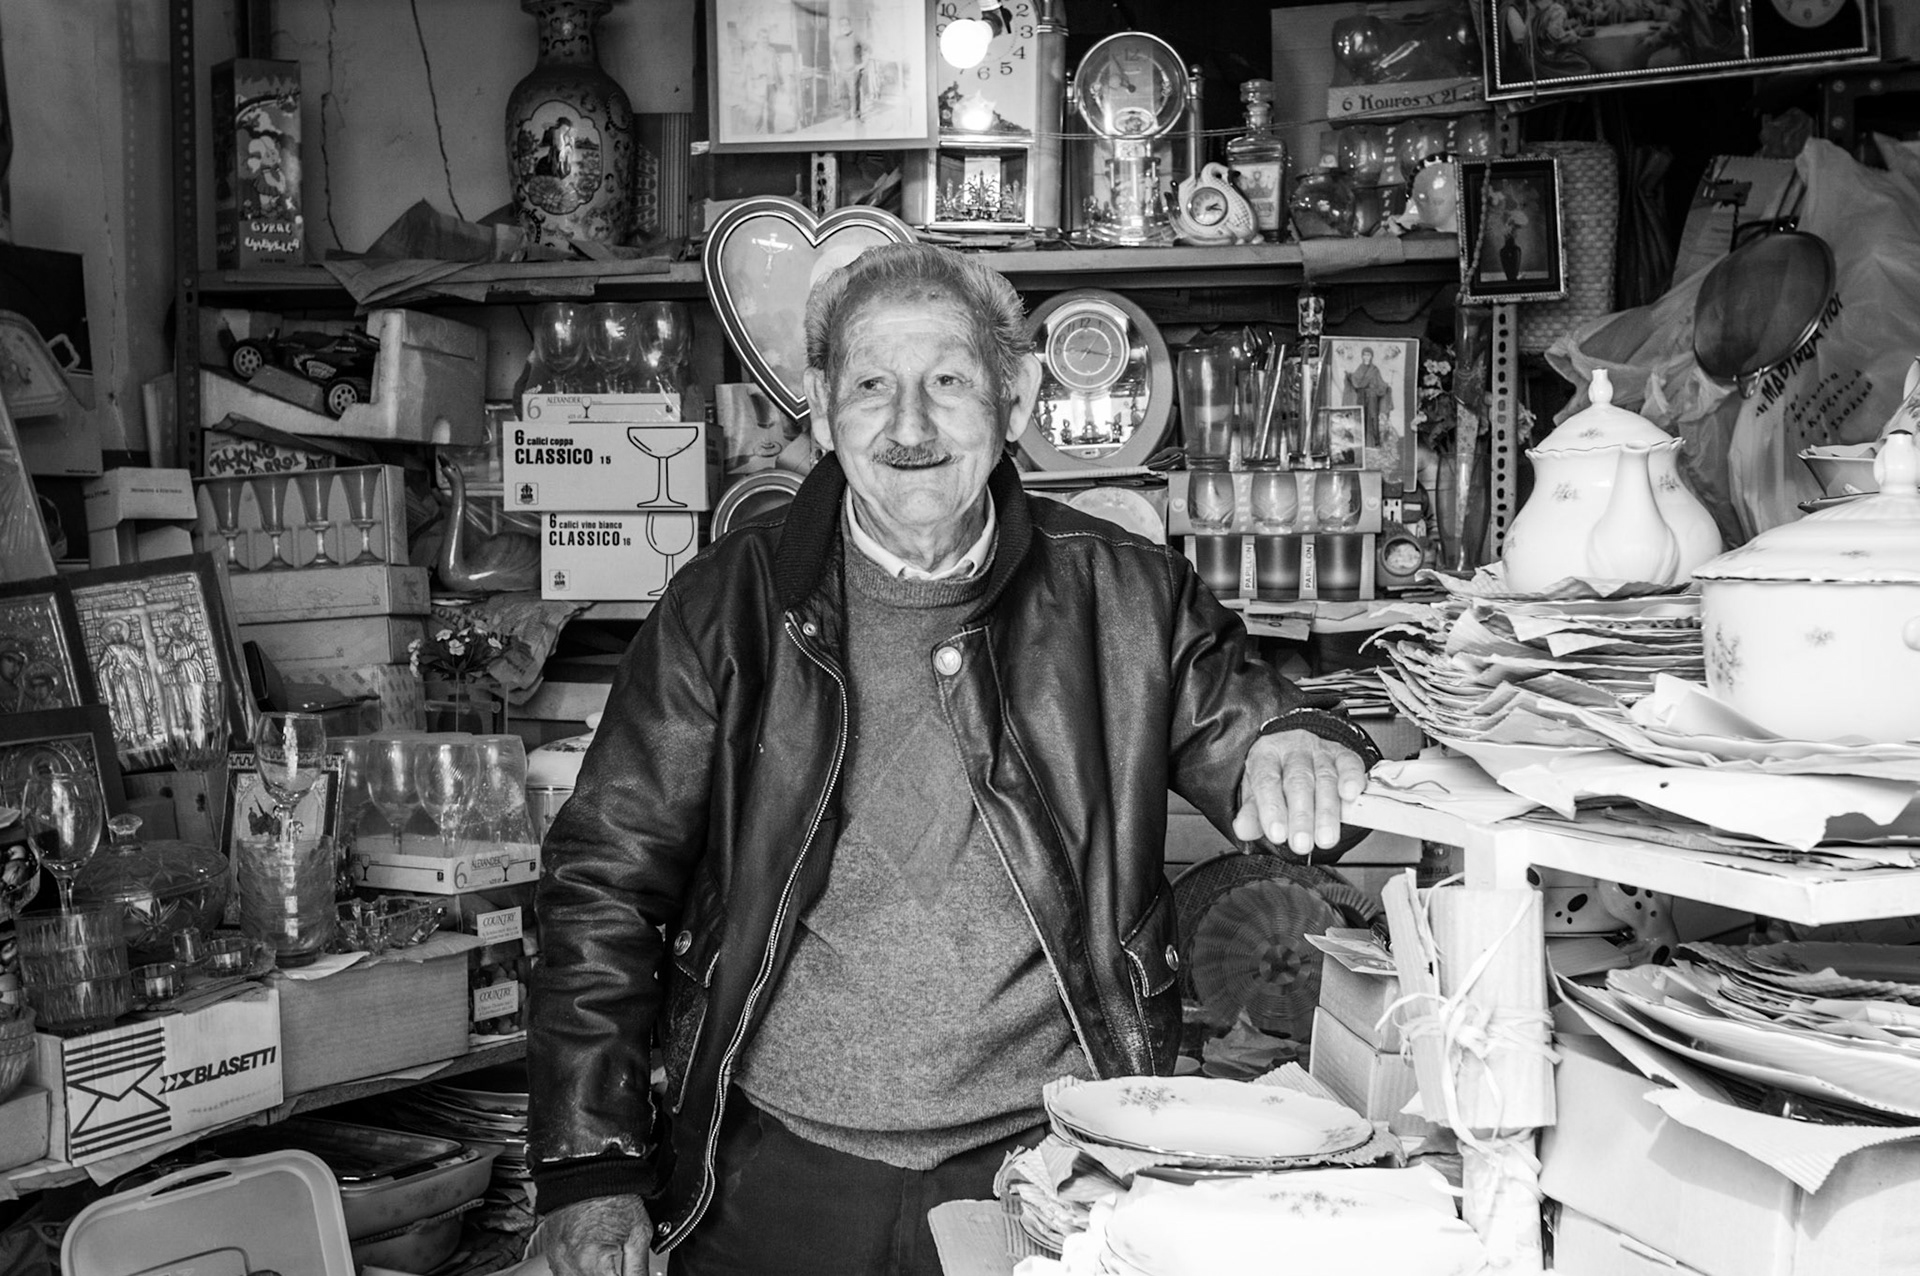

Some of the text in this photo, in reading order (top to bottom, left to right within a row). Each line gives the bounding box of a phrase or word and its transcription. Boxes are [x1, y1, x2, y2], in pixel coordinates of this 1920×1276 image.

[938, 3, 957, 17] 10
[1016, 3, 1029, 17] 2
[1020, 25, 1033, 39] 3
[1012, 46, 1026, 59] 4
[977, 66, 990, 81] 6
[1000, 61, 1013, 75] 5
[1342, 97, 1353, 111] 6
[1359, 94, 1421, 110] Kouros
[527, 396, 541, 420] 6
[515, 429, 574, 447] 6 calici coppa
[515, 448, 611, 465] CLASSICO 15
[549, 513, 623, 529] 6 calici vino bianco
[549, 531, 631, 546] CLASSICO 16
[1245, 546, 1253, 589] PAPILLON
[1305, 546, 1313, 589] PAPILLON
[454, 861, 467, 889] 6
[482, 912, 517, 927] COUNTRY
[479, 986, 513, 1002] COUNTRY
[194, 1046, 277, 1084] BLASETTI
